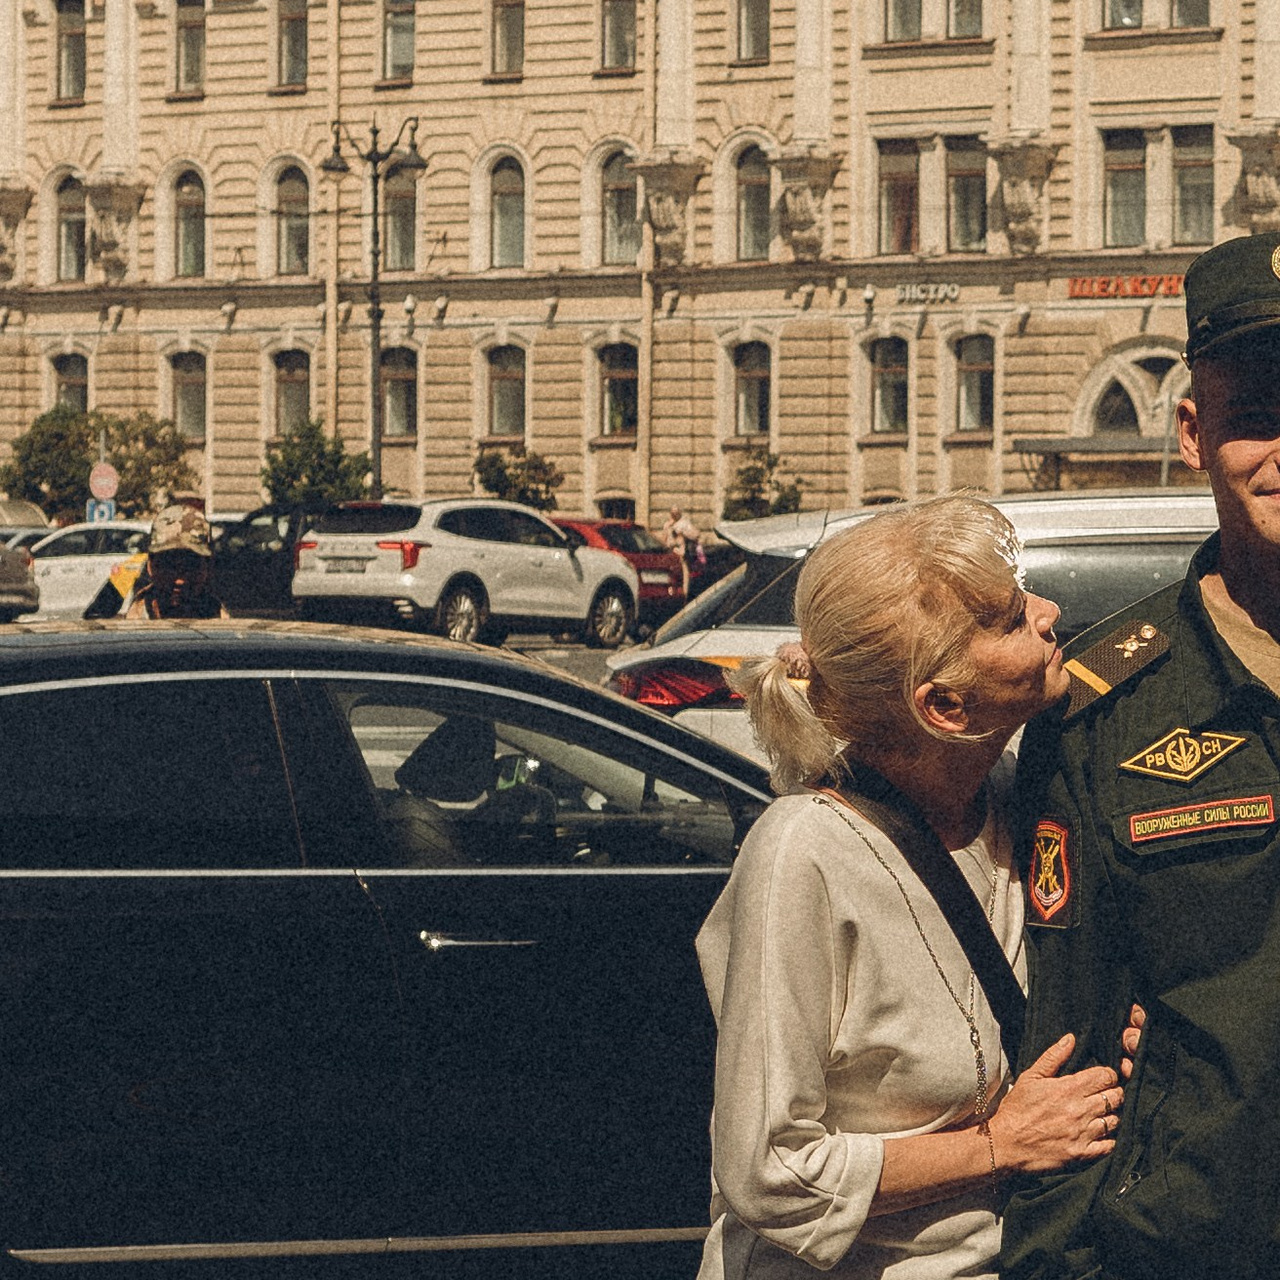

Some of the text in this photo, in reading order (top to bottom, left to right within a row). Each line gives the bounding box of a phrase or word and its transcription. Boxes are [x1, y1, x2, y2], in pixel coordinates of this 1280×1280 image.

[1145, 739, 1221, 767] РВ СН
[1135, 802, 1269, 835] ВООРУЖЕННЫЕ СИЛЫ РОССИИ
